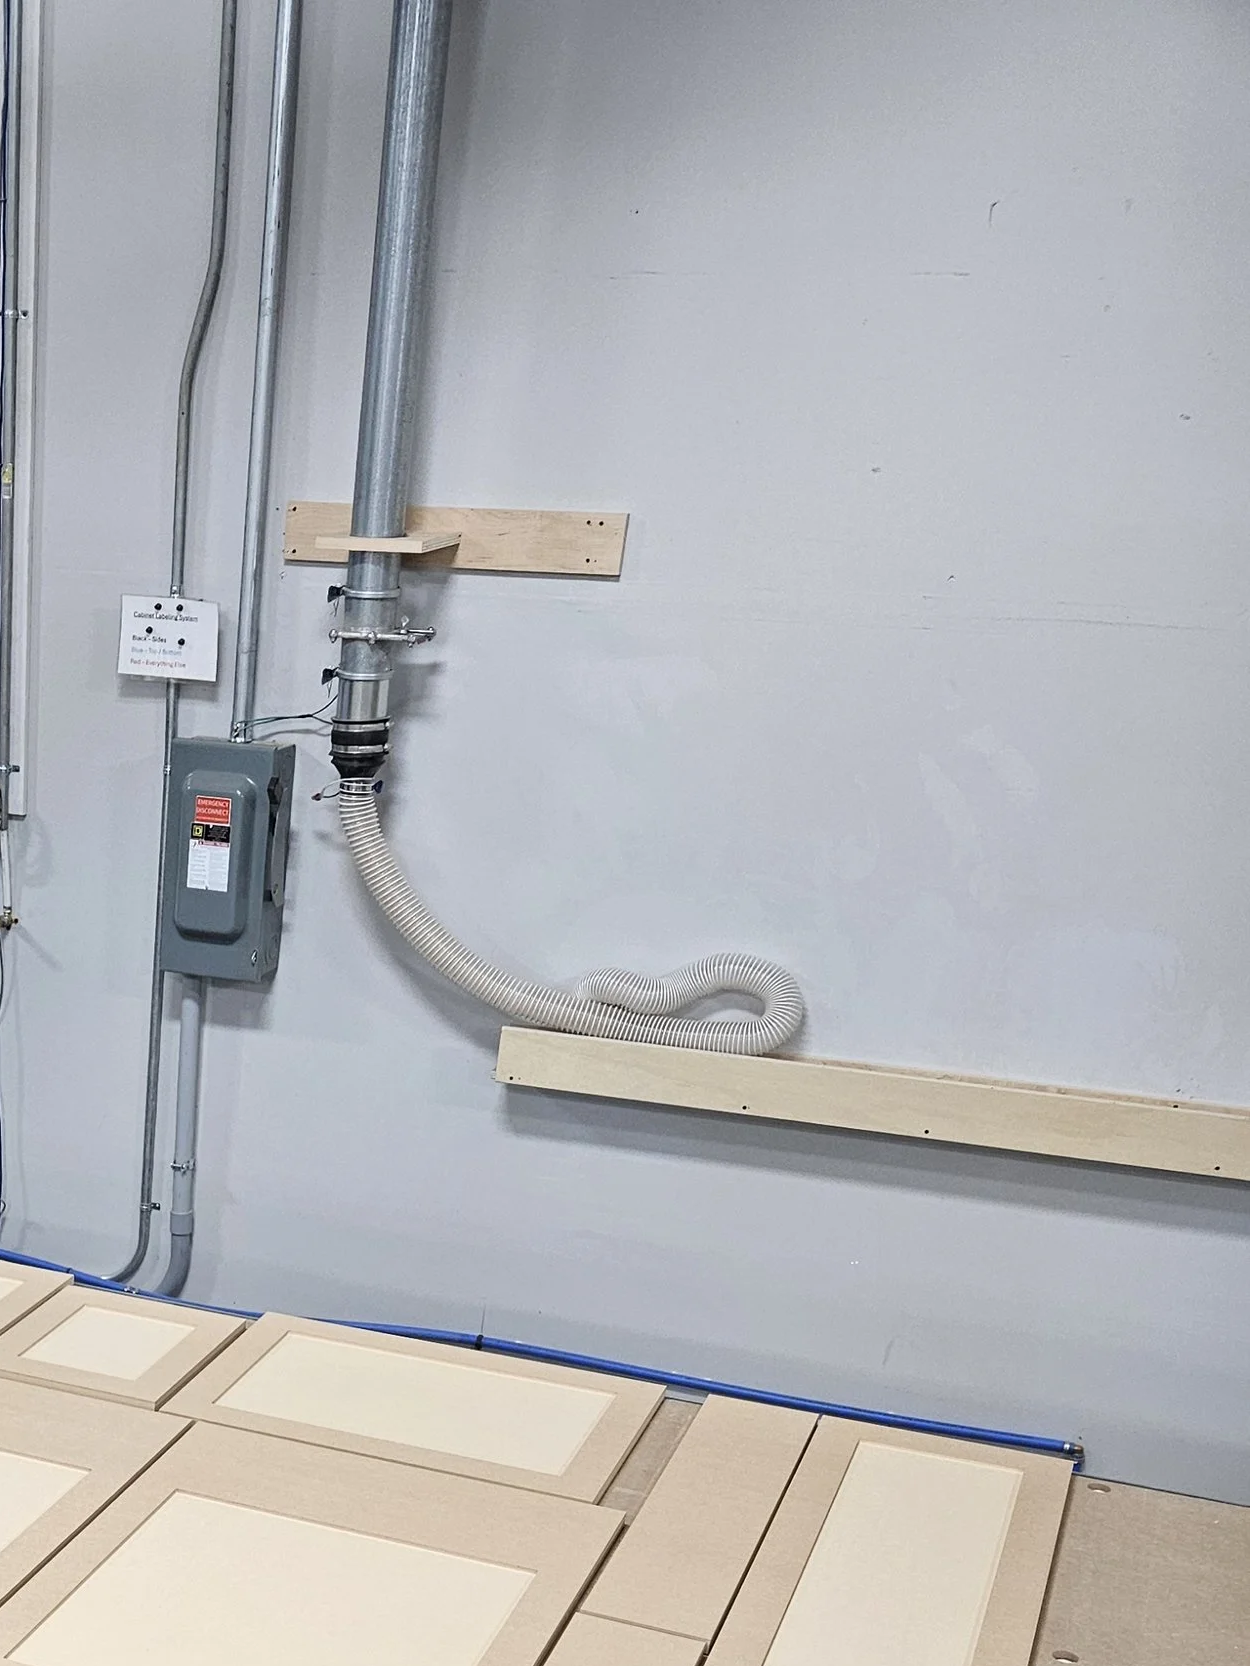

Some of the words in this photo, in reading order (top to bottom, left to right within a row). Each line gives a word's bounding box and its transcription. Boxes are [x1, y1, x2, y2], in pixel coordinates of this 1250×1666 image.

[133, 611, 155, 619] Cabinet
[155, 612, 178, 621] Labeling
[178, 615, 199, 623] System
[146, 660, 173, 668] Everything
[197, 799, 229, 808] EMERGENCY
[196, 807, 229, 817] DISCONNECT
